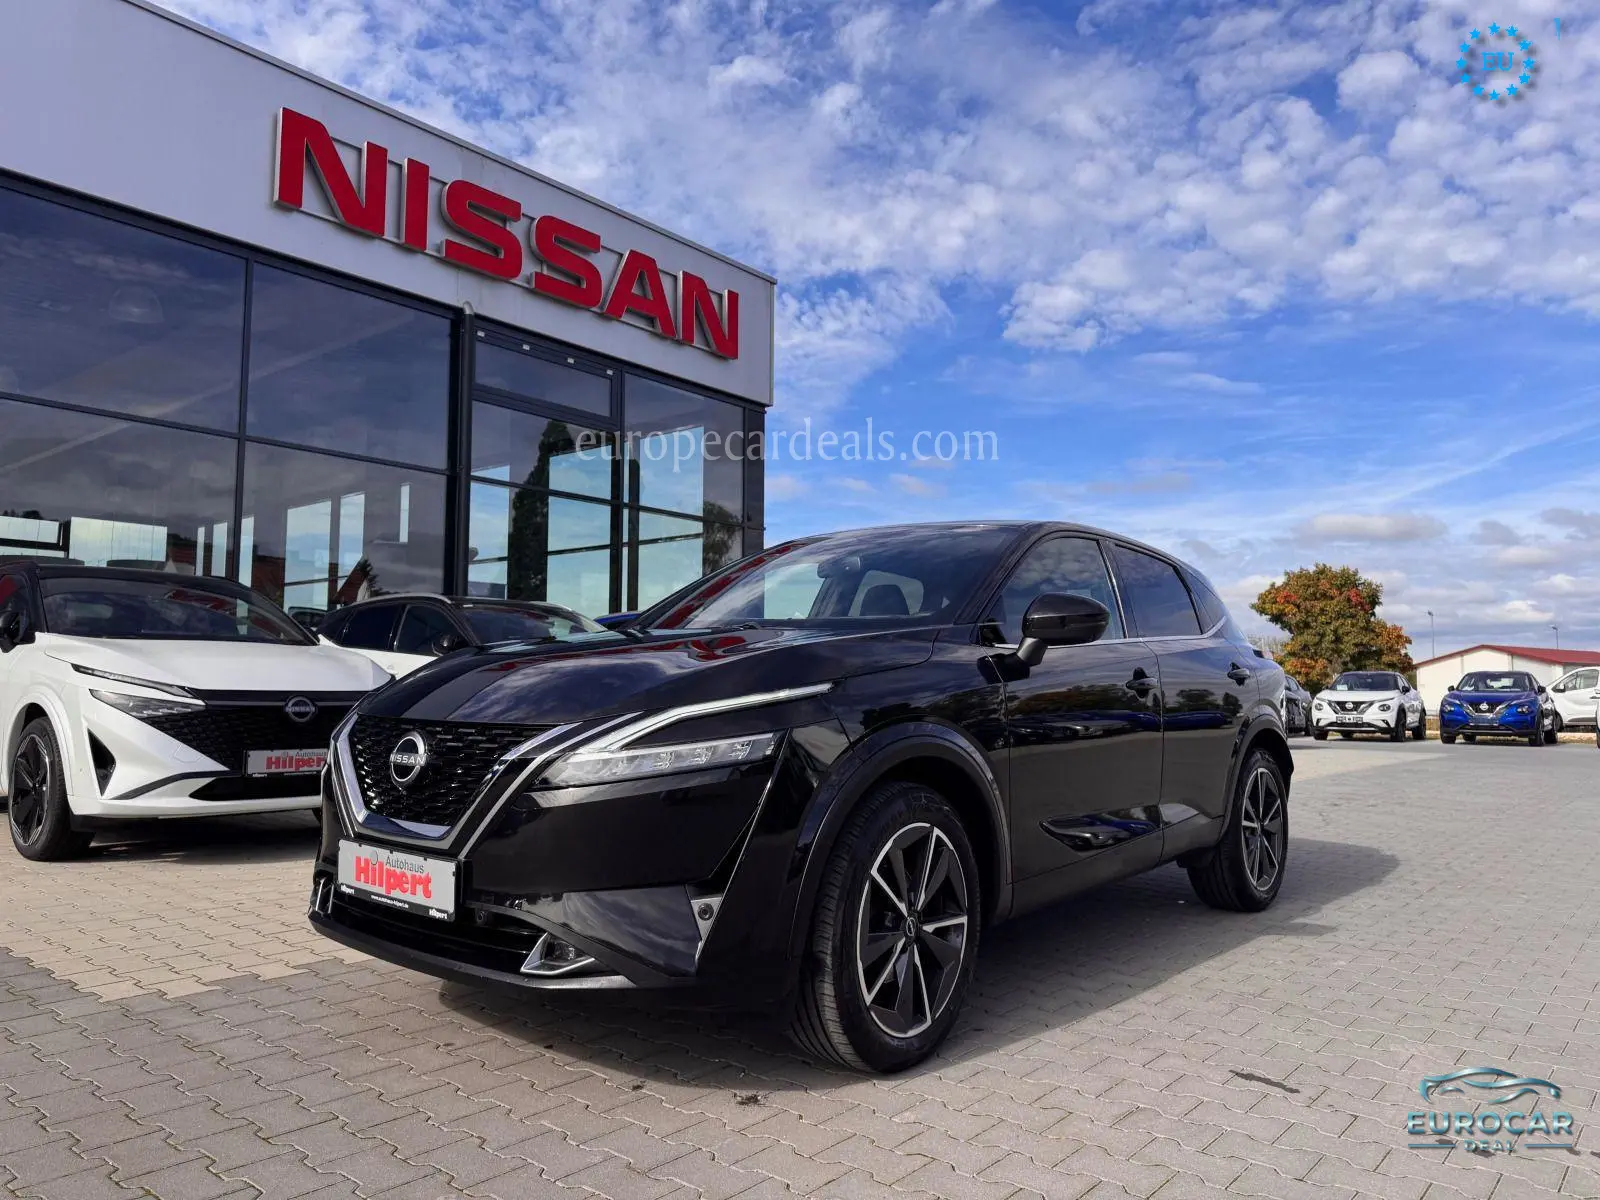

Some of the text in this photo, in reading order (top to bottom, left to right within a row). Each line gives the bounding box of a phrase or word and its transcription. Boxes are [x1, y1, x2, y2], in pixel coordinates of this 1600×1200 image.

[274, 106, 739, 360] NISSAN
[265, 755, 327, 771] Hilper
[390, 753, 426, 765] NISSAN
[385, 854, 425, 874] Autohaus
[355, 855, 432, 899] Hilpert
